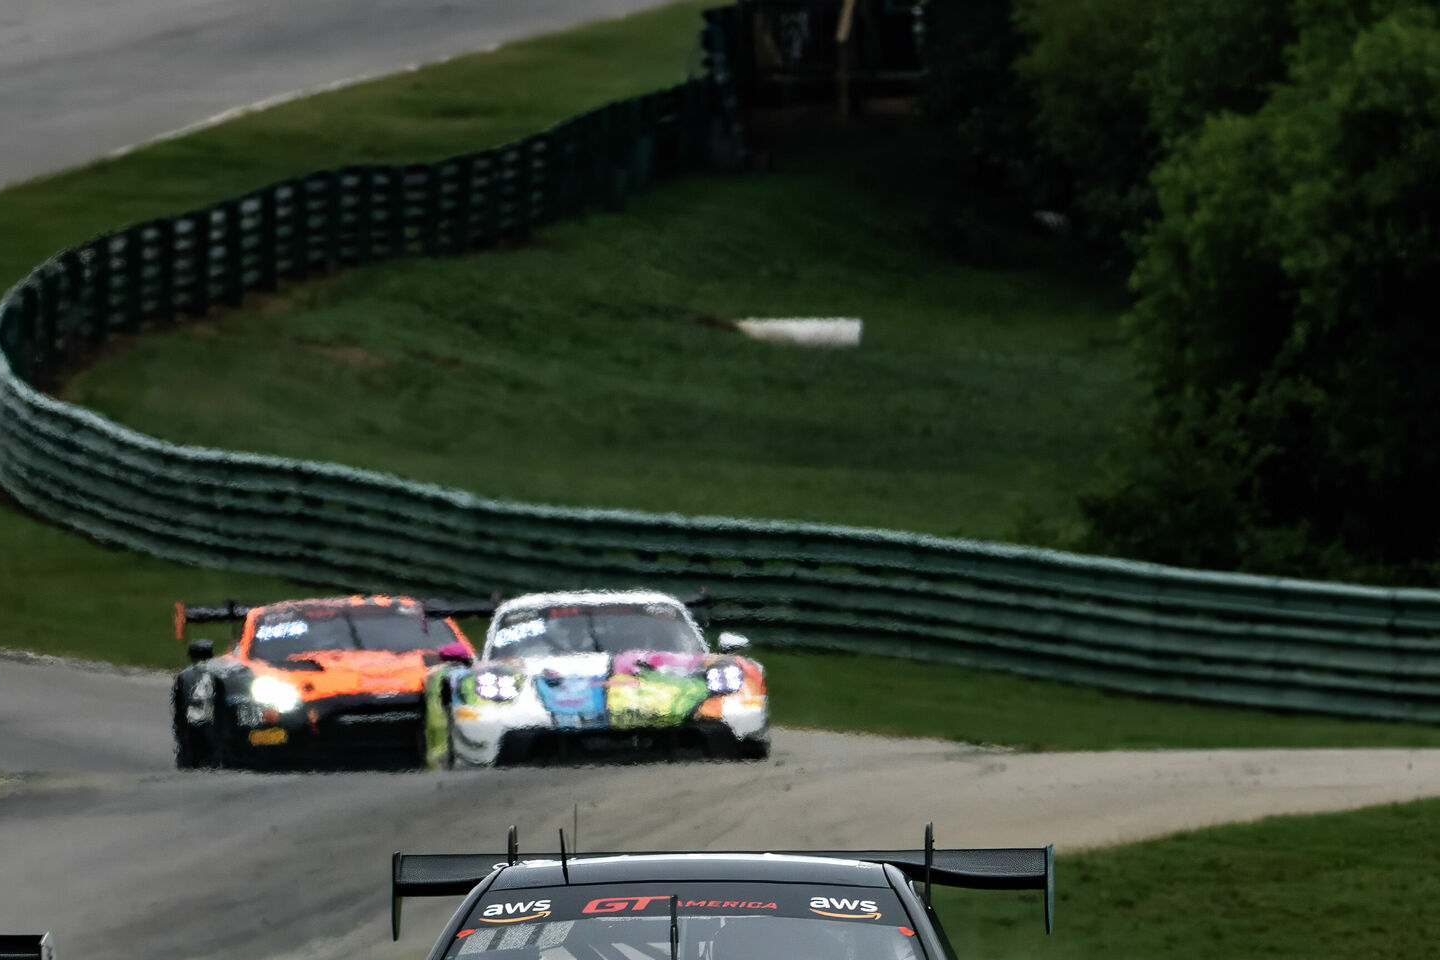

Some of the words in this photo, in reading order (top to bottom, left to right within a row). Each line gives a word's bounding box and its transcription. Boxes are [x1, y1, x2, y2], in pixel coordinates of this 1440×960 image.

[483, 899, 551, 917] aws
[582, 896, 671, 914] GT
[810, 897, 879, 913] aws
